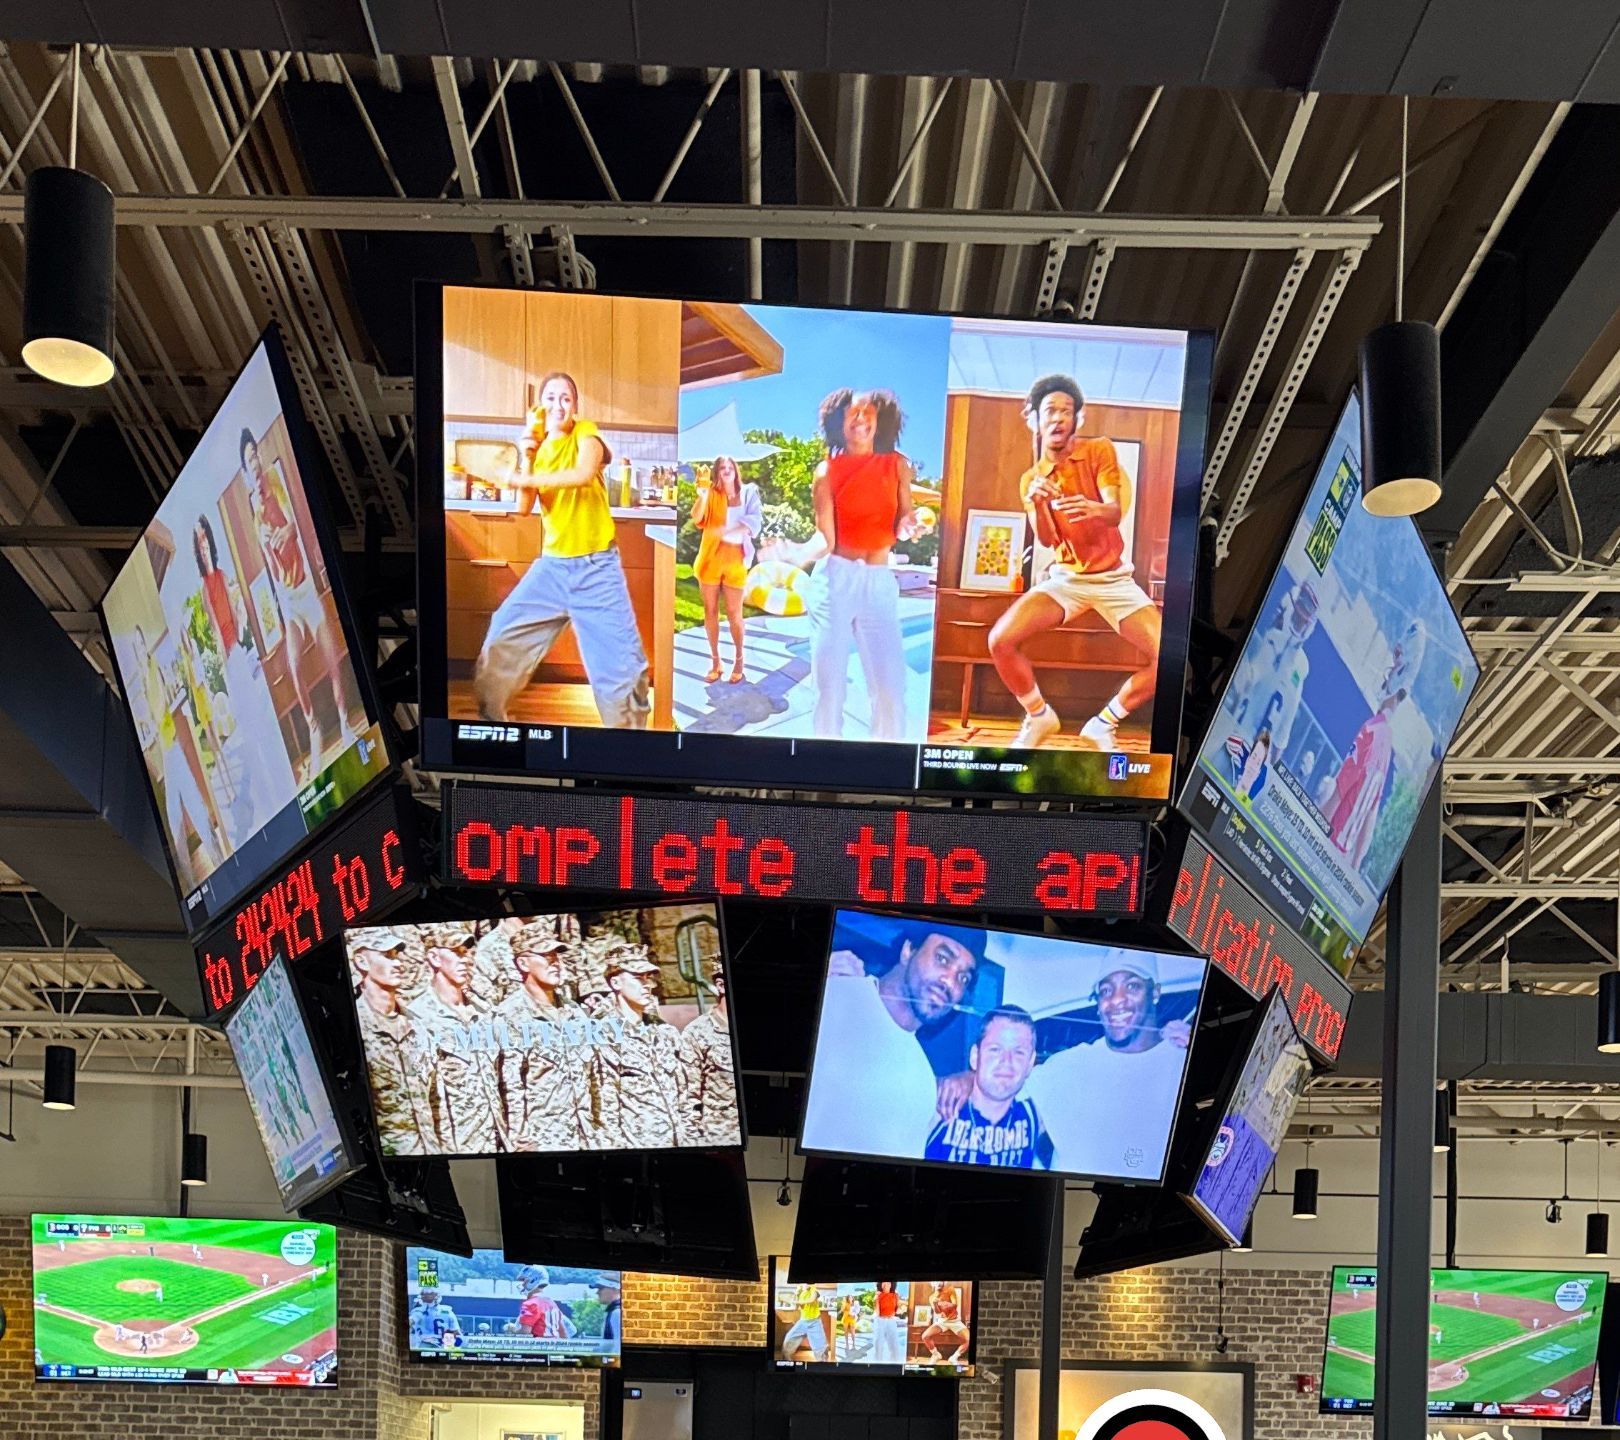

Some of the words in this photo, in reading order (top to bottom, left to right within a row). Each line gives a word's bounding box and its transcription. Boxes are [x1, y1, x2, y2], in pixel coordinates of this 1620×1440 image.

[1307, 512, 1336, 571] PASS
[458, 725, 520, 742] ESPN2
[528, 729, 552, 740] MLB
[924, 749, 942, 760] 3M
[943, 749, 974, 761] OPEN
[1128, 763, 1150, 774] LIVE
[846, 810, 987, 905] the
[1035, 850, 1140, 912] ap
[205, 953, 234, 1011] to
[332, 854, 372, 922] to
[453, 1016, 627, 1051] MILITARY
